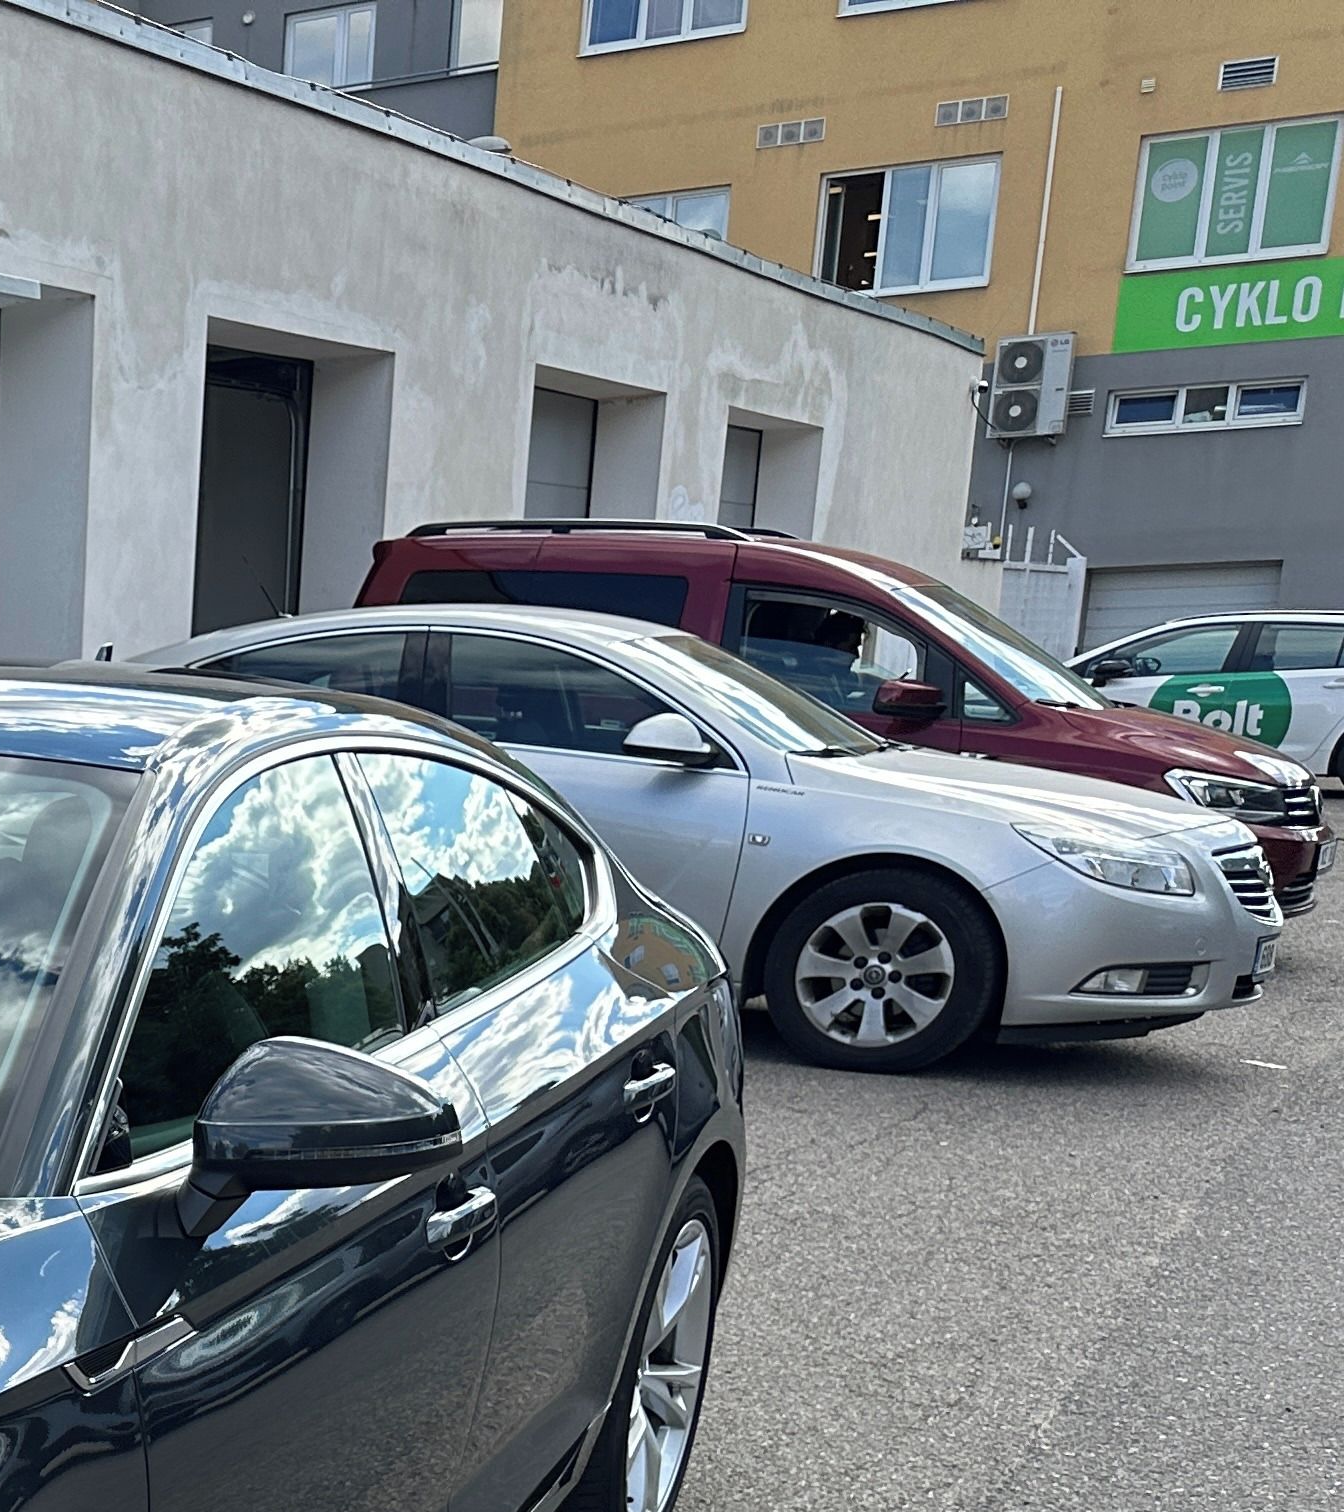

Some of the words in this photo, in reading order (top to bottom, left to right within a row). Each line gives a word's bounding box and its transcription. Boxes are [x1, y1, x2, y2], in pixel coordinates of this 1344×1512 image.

[1216, 151, 1253, 235] SERVIS
[1175, 275, 1323, 333] CYKLO
[1172, 699, 1264, 736] Bolt
